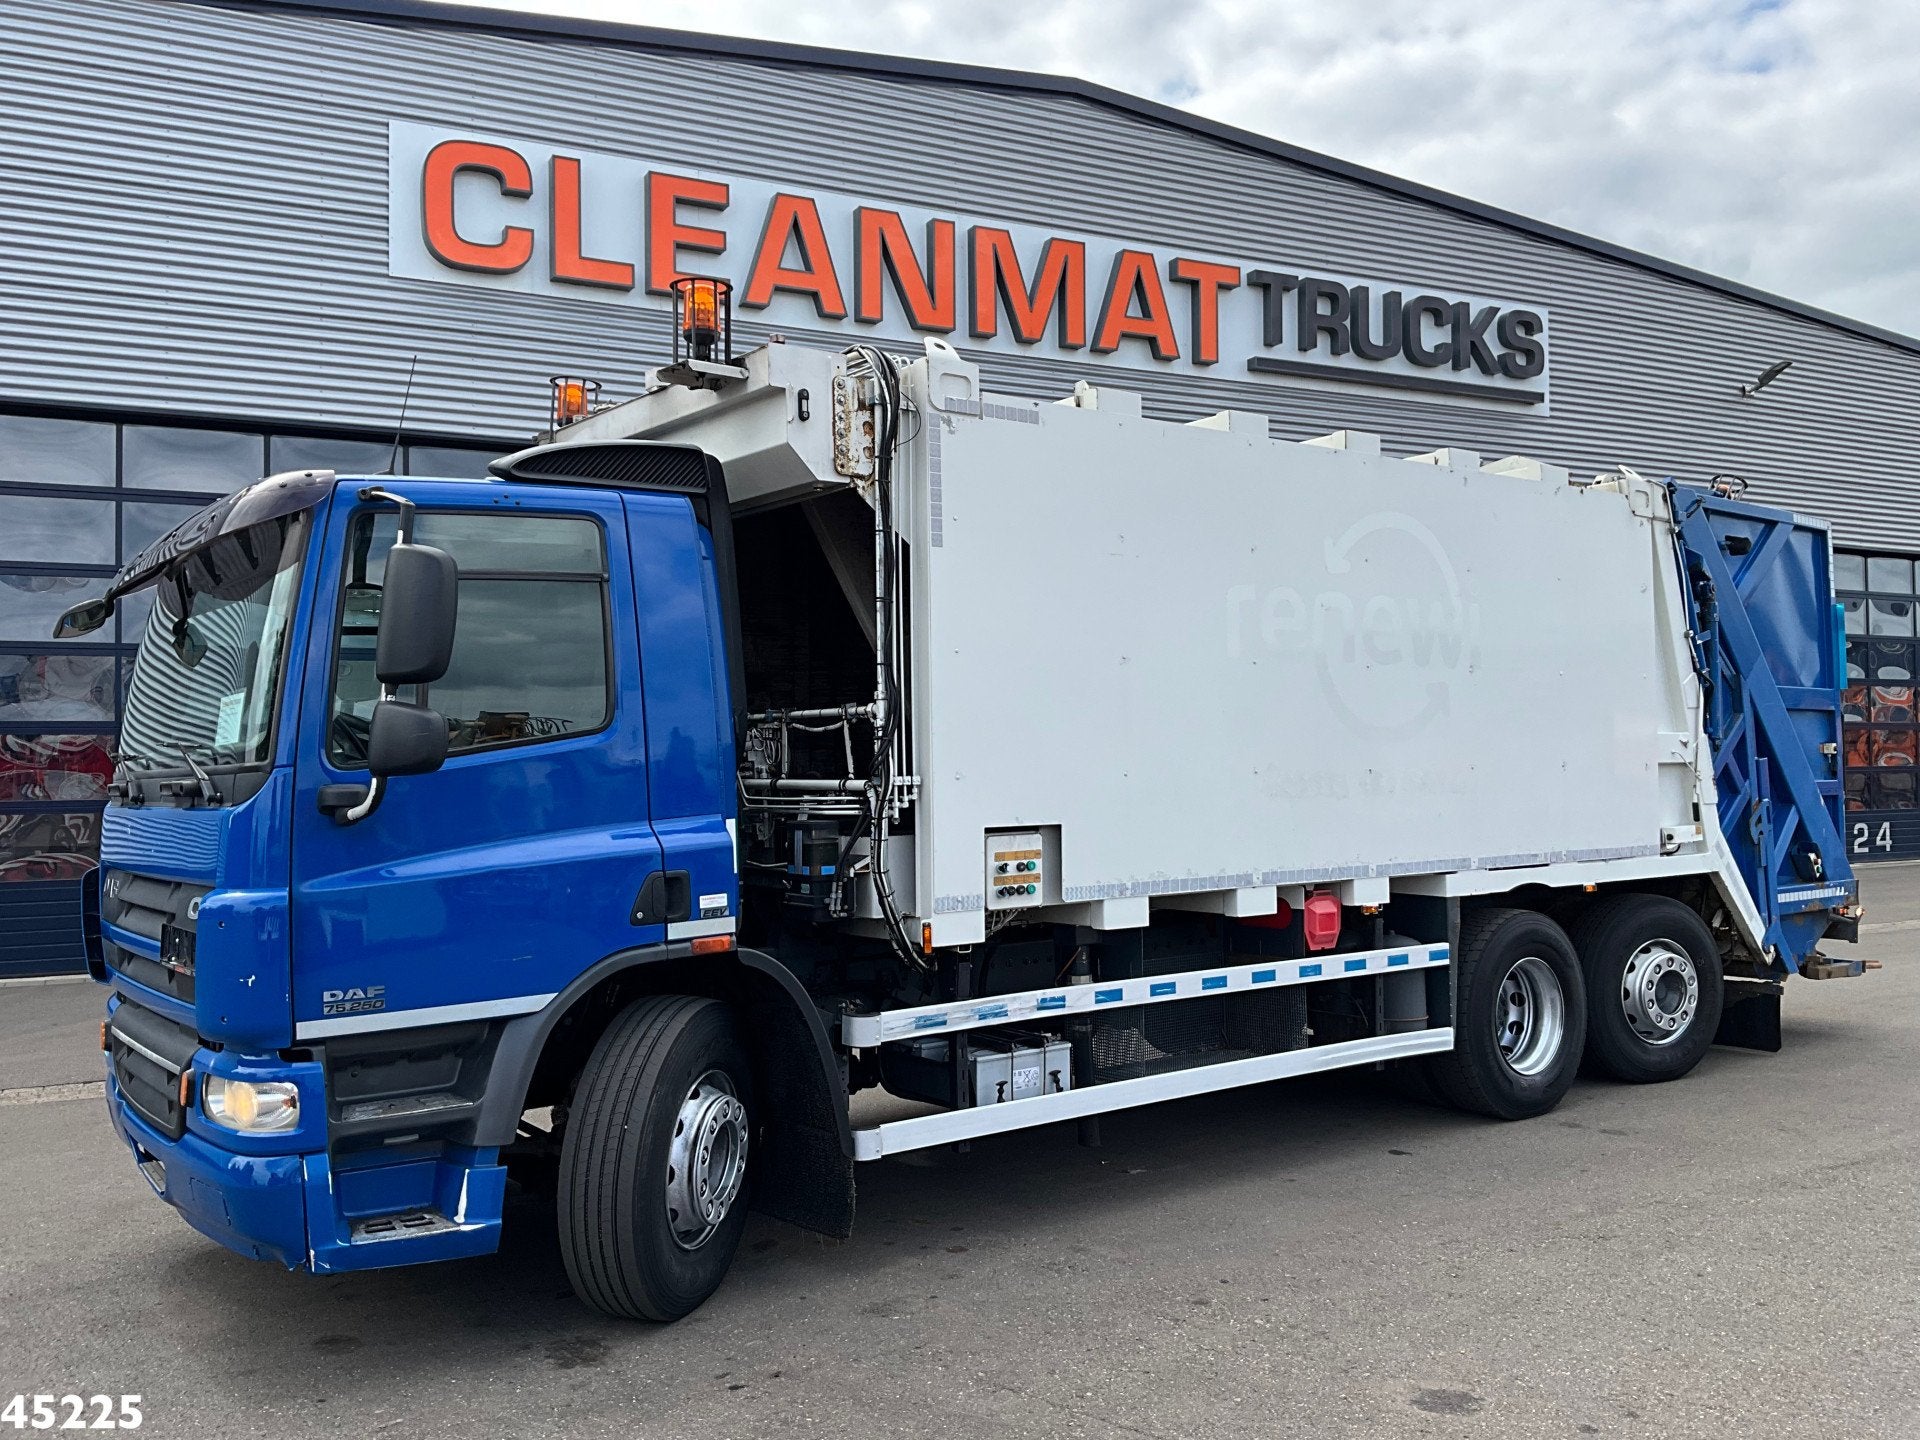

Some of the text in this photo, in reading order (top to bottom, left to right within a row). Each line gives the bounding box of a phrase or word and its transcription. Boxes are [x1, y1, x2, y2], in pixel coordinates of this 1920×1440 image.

[421, 139, 1545, 380] CLEANMAT TRUCKS
[1853, 821, 1893, 854] 24
[702, 907, 728, 918] EEV
[323, 985, 385, 1002] DAF
